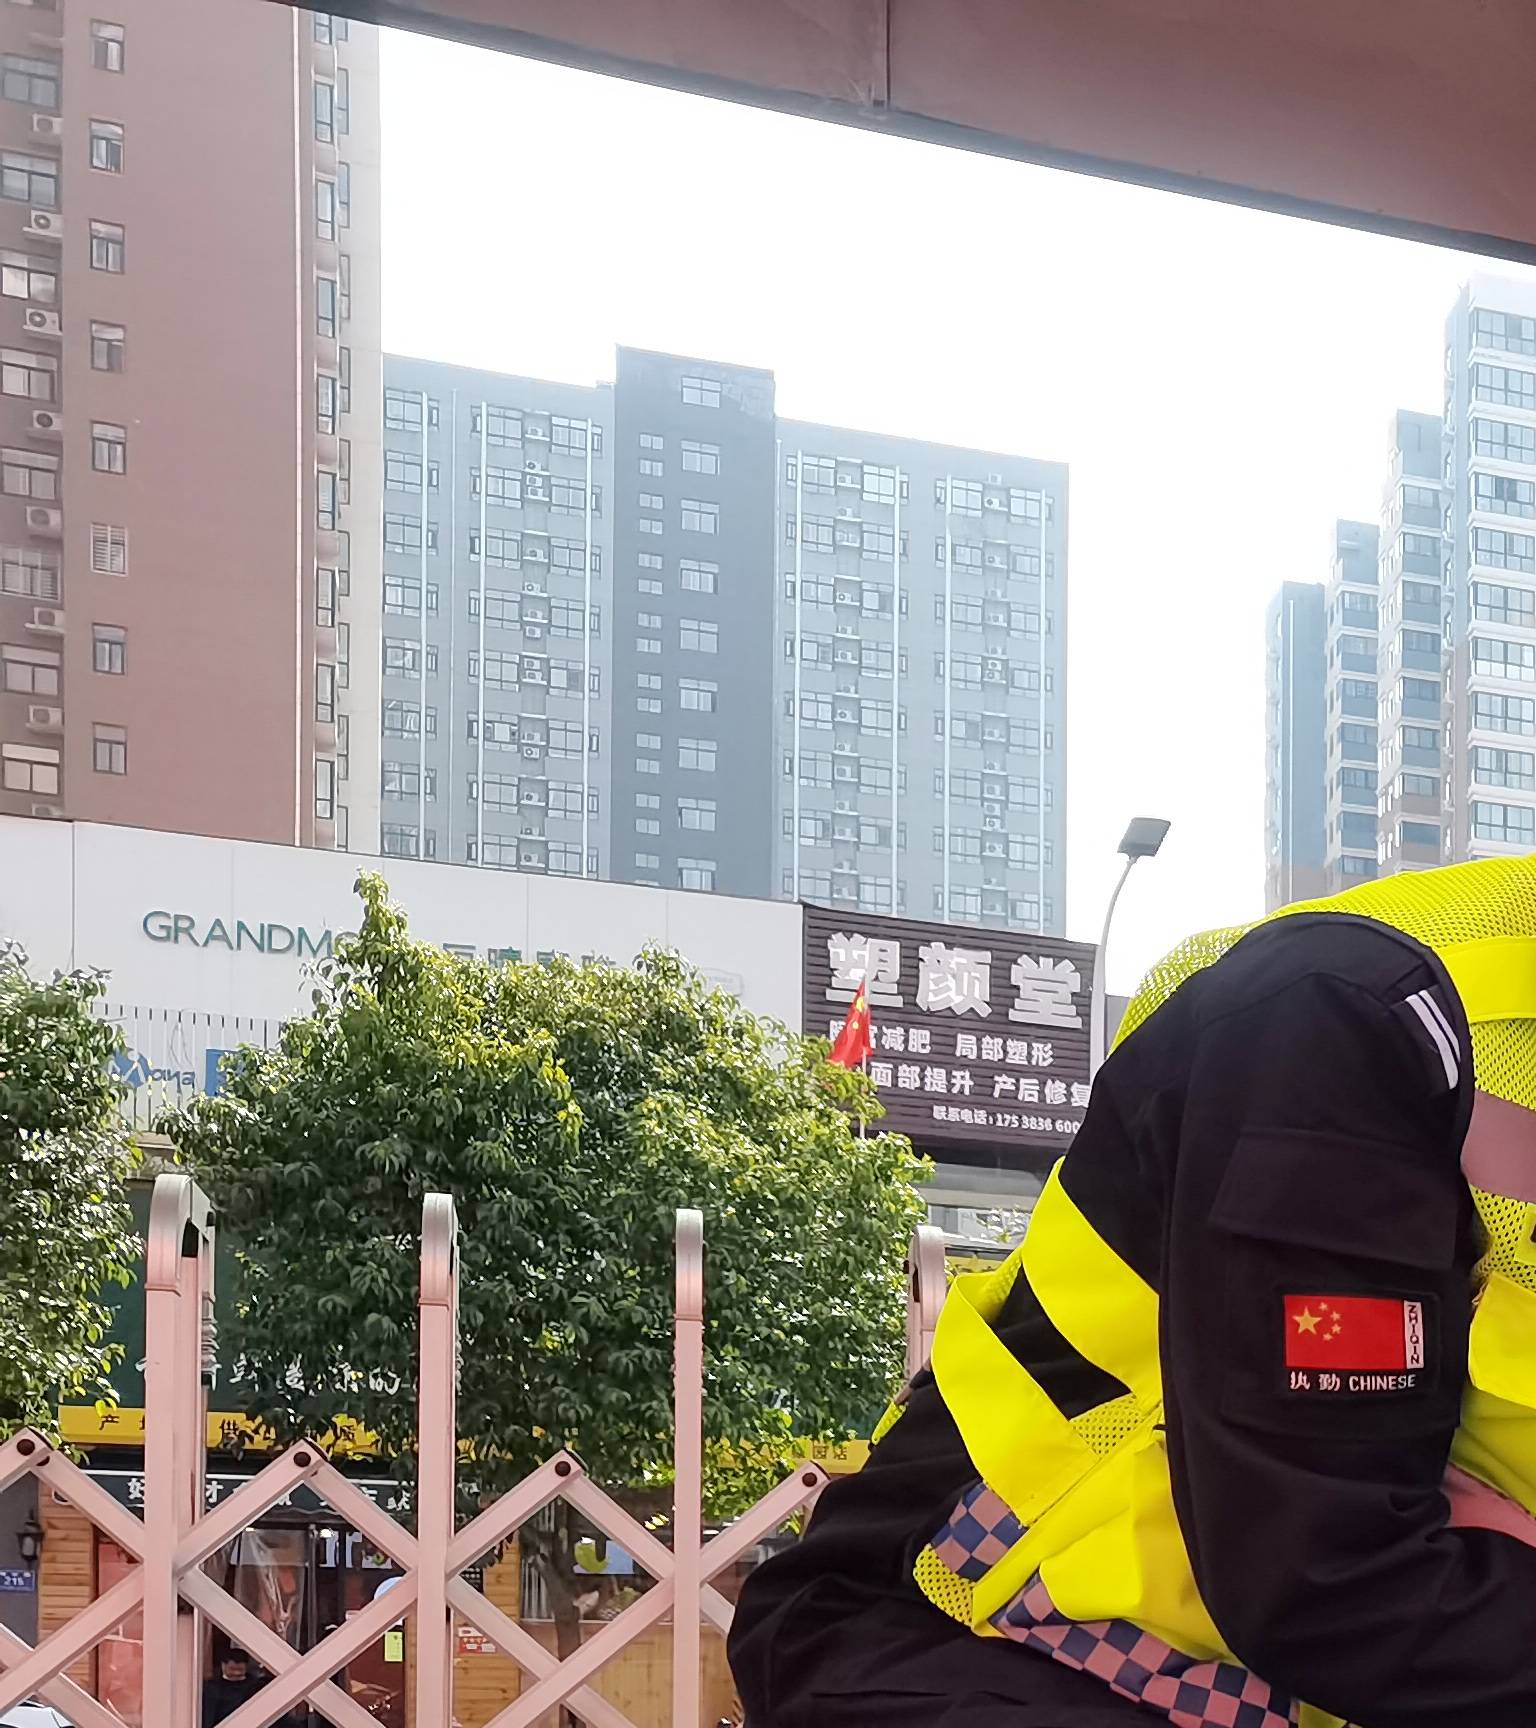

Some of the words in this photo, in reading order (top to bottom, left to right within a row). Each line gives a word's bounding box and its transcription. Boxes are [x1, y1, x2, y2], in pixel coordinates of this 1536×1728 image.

[825, 932, 1082, 1029] 塑颜堂
[955, 1034, 1054, 1067] 局部塑形
[869, 1062, 974, 1096] 面部提升
[993, 1074, 1091, 1109] 产后修复
[1408, 1304, 1420, 1365] ZHIQIN
[1348, 1373, 1416, 1391] CHINESE
